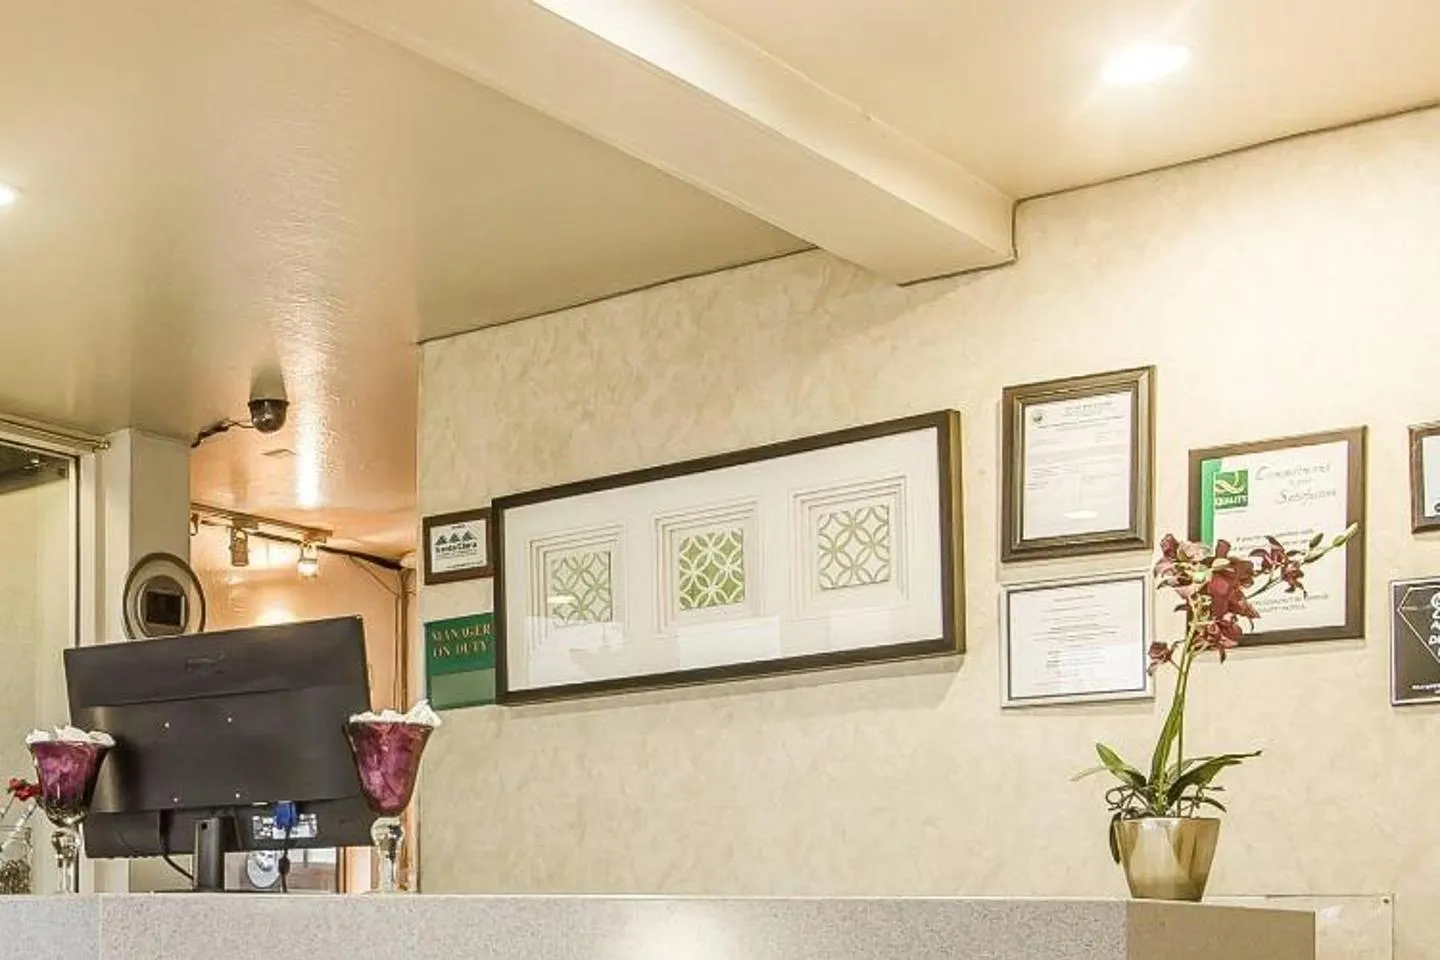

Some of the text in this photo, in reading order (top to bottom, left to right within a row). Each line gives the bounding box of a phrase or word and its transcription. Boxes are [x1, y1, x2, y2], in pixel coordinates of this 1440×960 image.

[1215, 494, 1248, 507] QUALITY
[431, 623, 492, 641] MANAGER
[432, 640, 488, 659] ON DUTY
